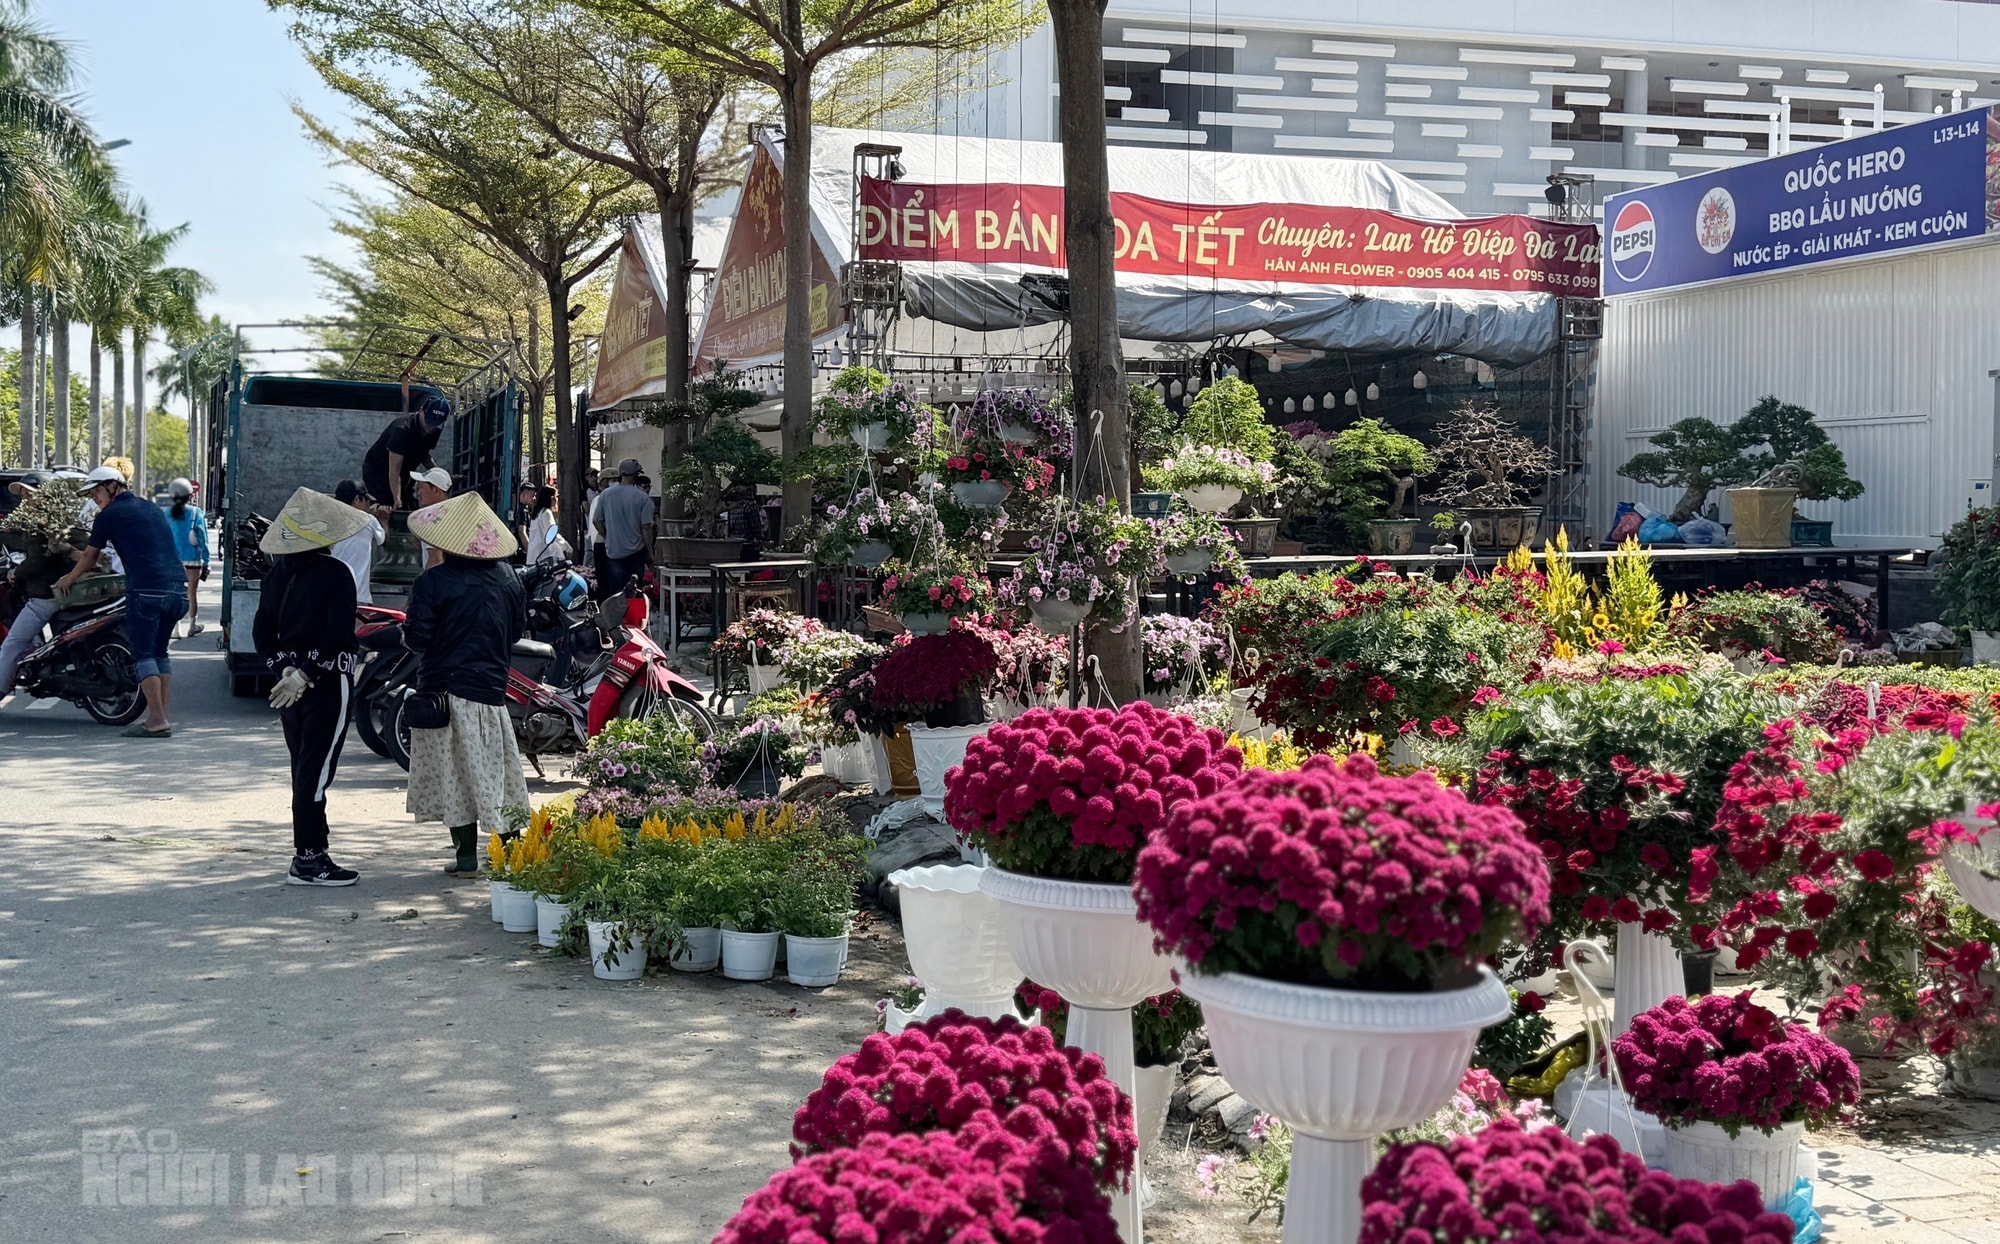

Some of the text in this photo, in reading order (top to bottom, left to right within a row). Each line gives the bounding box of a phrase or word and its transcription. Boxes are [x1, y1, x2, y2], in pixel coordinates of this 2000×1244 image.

[1933, 120, 1980, 144] L13-L14
[1784, 146, 1906, 193] QUỐC HERO
[860, 189, 1245, 267] ĐIỂM BÁN OA TẾT
[1769, 184, 1922, 233] BBQ LẨU NƯỚNG
[1257, 216, 1356, 258] Chuyên:
[1363, 222, 1414, 253] Lan
[1420, 219, 1458, 255] Hồ
[1462, 227, 1518, 264] Điệp
[1523, 230, 1558, 260] Đà
[1613, 229, 1653, 253] PEPSI
[1733, 244, 1771, 267] NƯỚC
[1774, 241, 1791, 261] ÉP
[1801, 232, 1830, 256] GIẢI
[1833, 226, 1873, 251] KHÁT
[1884, 220, 1917, 242] KEM
[1920, 209, 1968, 236] CUỘN
[1264, 256, 1296, 272] HÂN
[1299, 260, 1330, 274] ANH
[1333, 262, 1395, 277] FLOWER
[1406, 266, 1443, 279] 0905
[1447, 267, 1475, 280] 404
[1478, 268, 1501, 280] 415
[1512, 269, 1545, 283] 0795
[1547, 272, 1570, 286] 633
[1572, 275, 1598, 289] 099
[616, 657, 636, 671] YAMAHA
